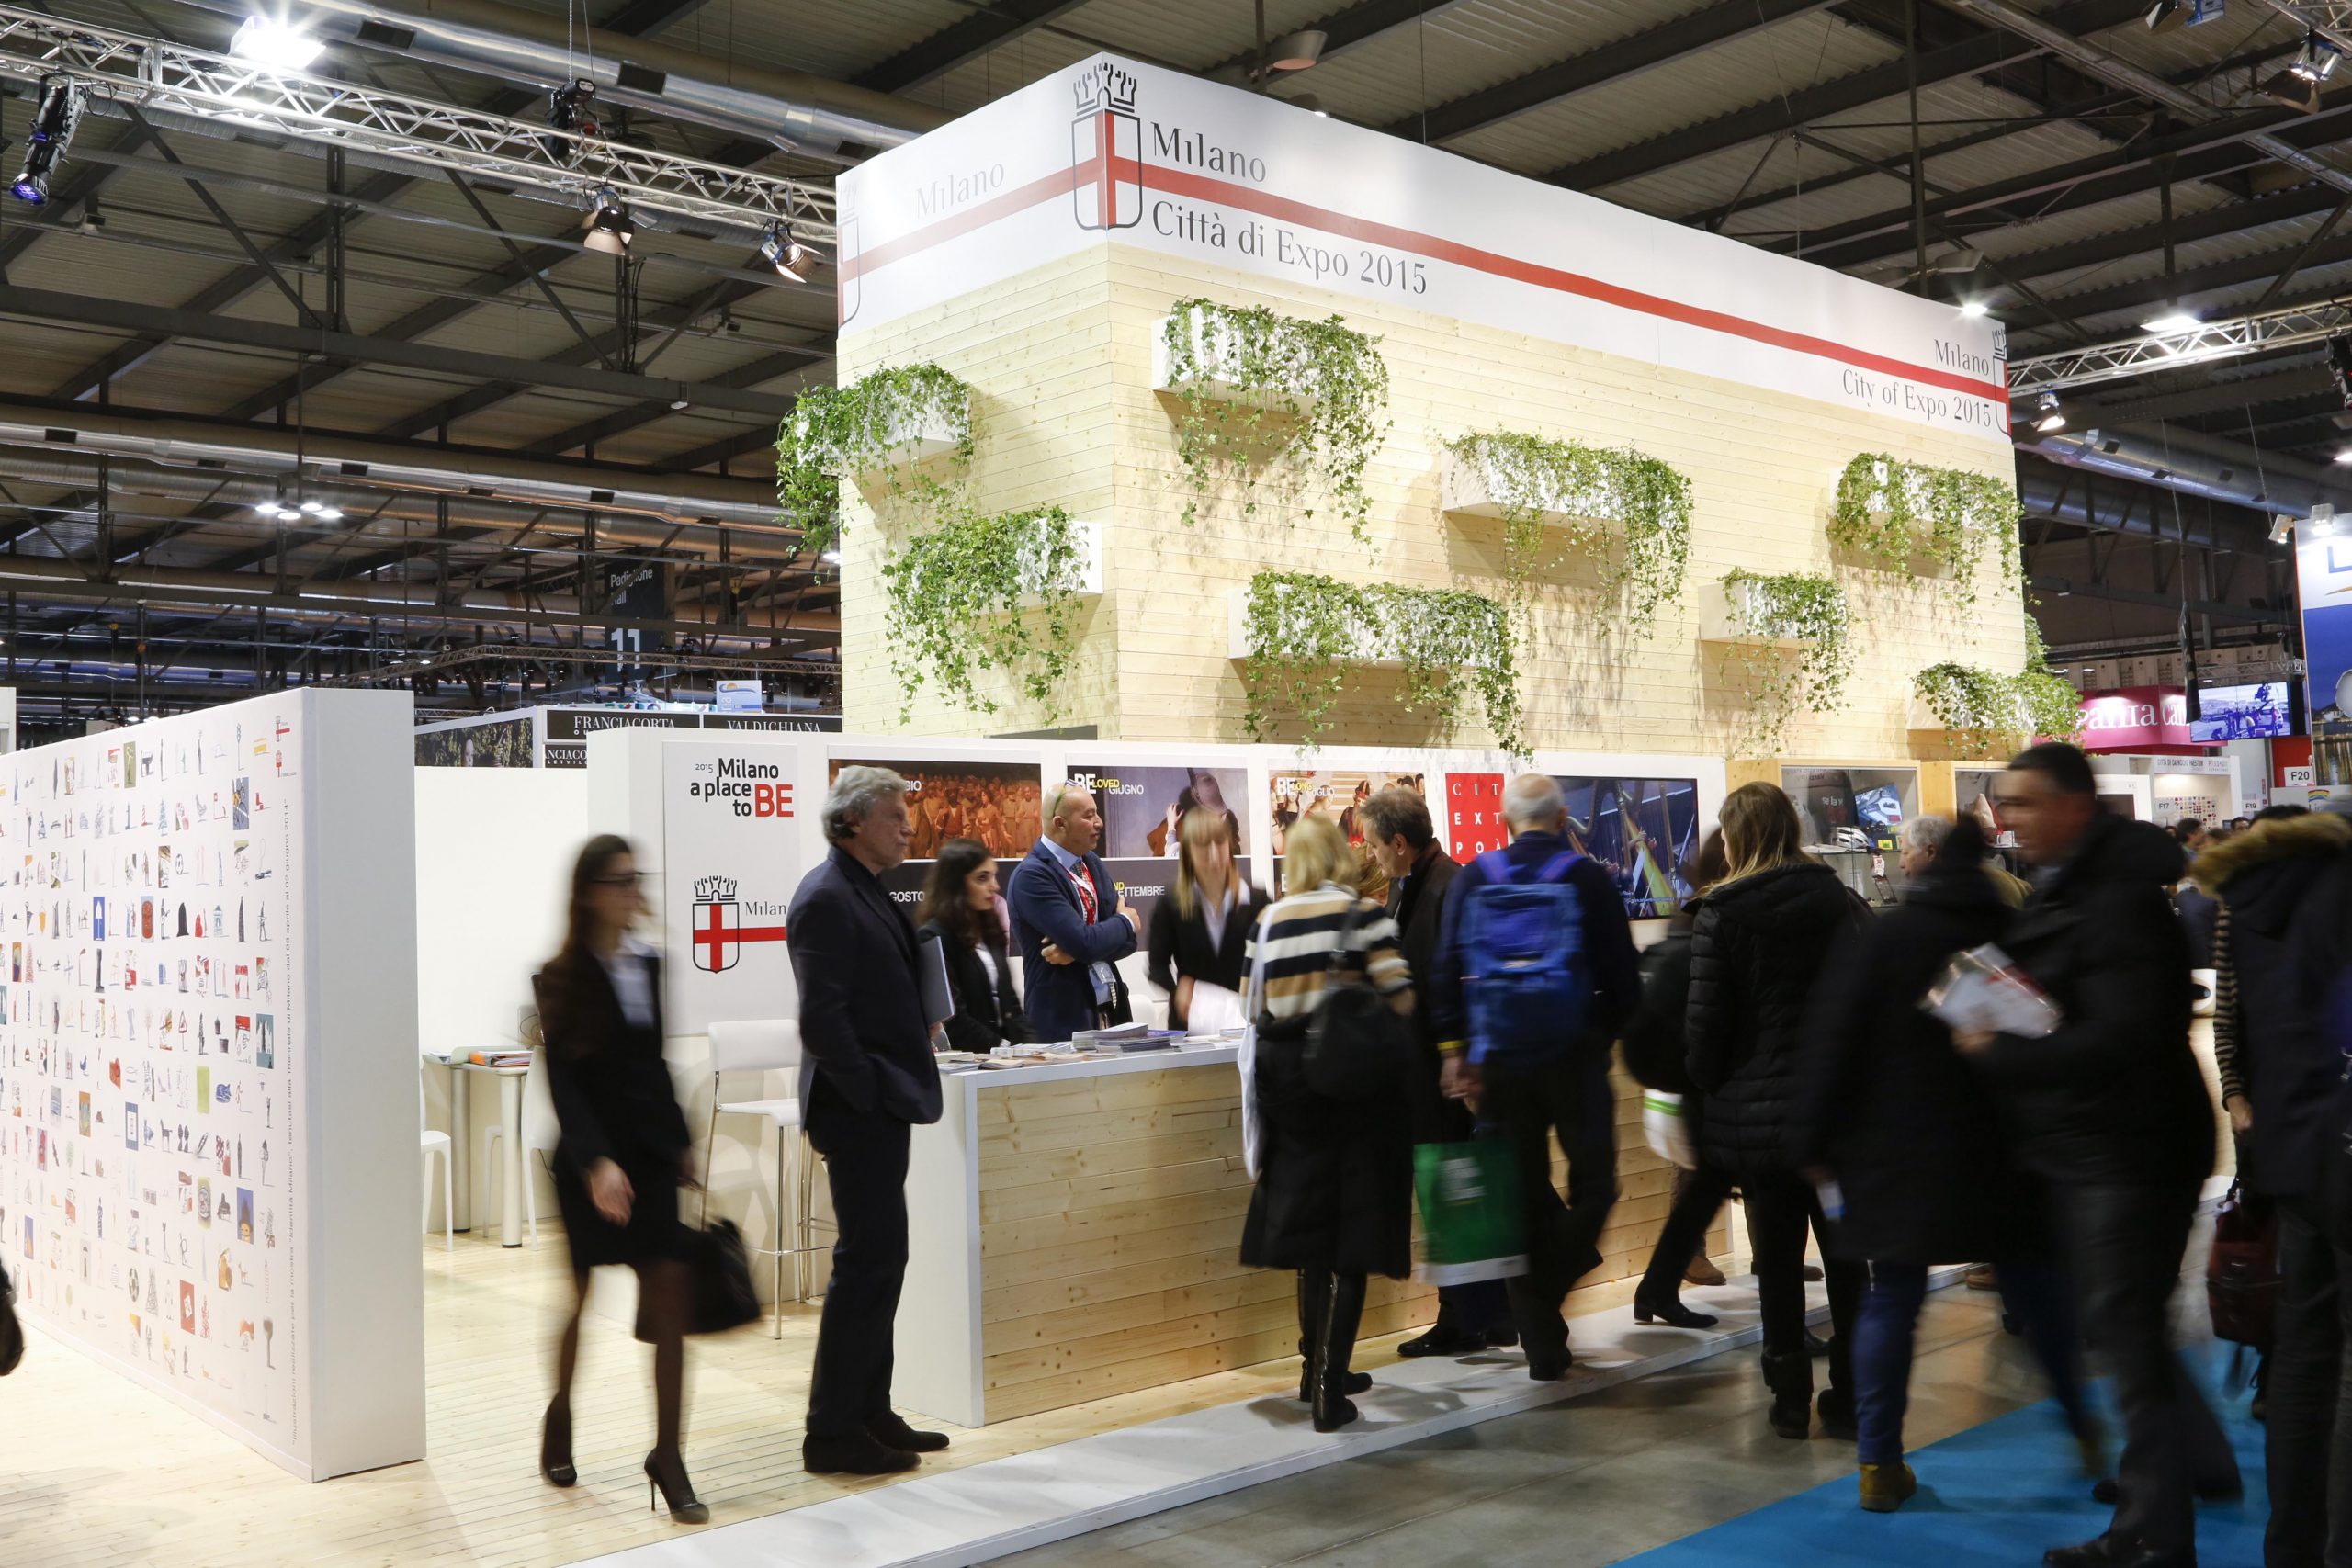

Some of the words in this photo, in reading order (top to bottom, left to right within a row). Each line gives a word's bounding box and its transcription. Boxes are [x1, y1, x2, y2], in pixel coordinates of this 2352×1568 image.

[1150, 121, 1266, 182] Milano
[916, 164, 1004, 220] Milano
[1153, 200, 1226, 248] Città
[1238, 220, 1264, 257] di
[1275, 229, 1348, 280] Expo
[1360, 250, 1427, 294] 2015
[1934, 339, 1989, 376] Milano
[1843, 368, 1875, 408] City
[1883, 381, 1899, 406] of
[1905, 384, 1947, 422] Expo
[1953, 396, 1991, 427] 2015
[611, 589, 627, 605] all
[611, 627, 640, 672] 11
[695, 763, 714, 773] 2015
[718, 758, 779, 779] Milano
[2290, 771, 2310, 781] F20
[690, 782, 700, 796] a
[705, 776, 752, 803] place
[732, 799, 752, 817] to
[754, 784, 794, 818] BE
